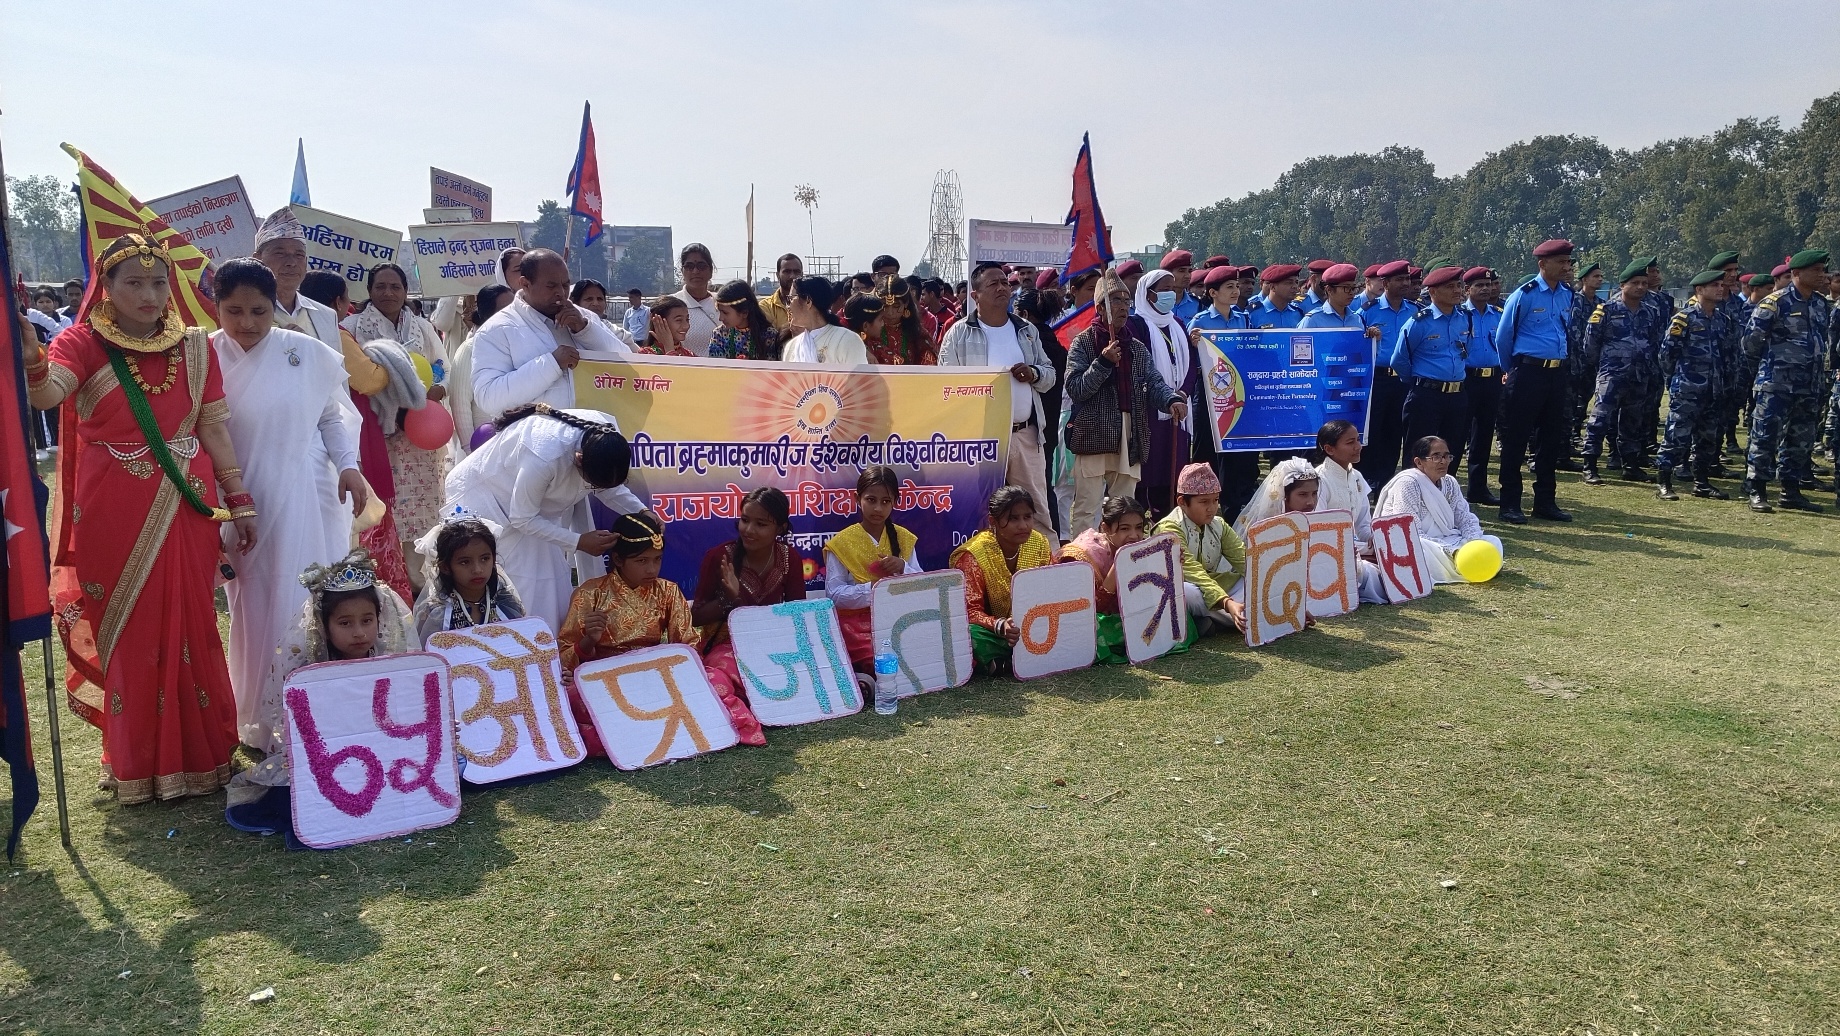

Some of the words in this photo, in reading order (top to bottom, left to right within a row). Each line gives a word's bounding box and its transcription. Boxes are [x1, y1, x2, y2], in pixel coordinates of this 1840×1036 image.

[195, 219, 216, 240] लागि
[358, 239, 395, 261] परम
[439, 259, 477, 279] अहिंसाले
[633, 374, 673, 393] शान्ति
[943, 385, 995, 401] सु-स्वागतम्
[678, 433, 807, 477] ब्रह्माकुमारीज
[809, 433, 884, 475] ईश्वरीय
[885, 432, 999, 472] विश्वविद्यालय
[652, 483, 744, 523] राजयो
